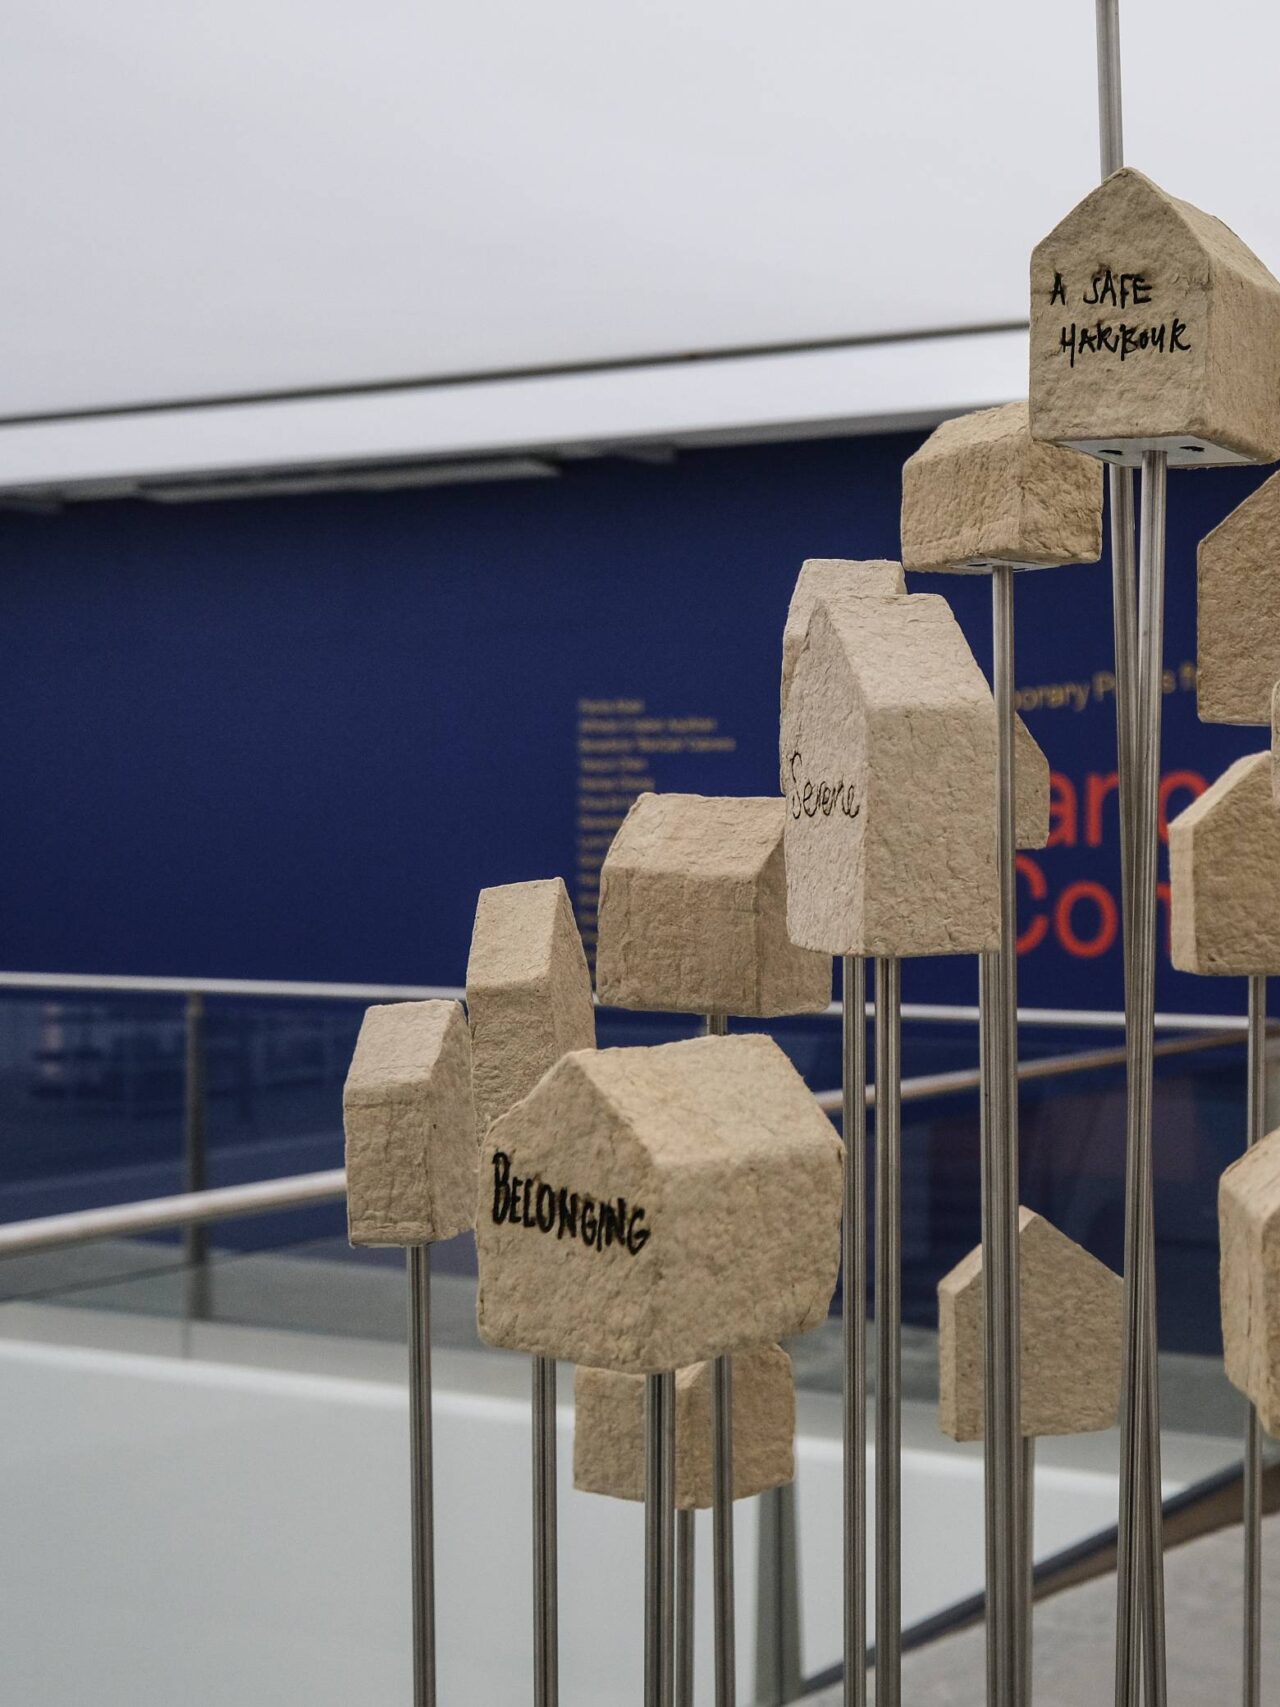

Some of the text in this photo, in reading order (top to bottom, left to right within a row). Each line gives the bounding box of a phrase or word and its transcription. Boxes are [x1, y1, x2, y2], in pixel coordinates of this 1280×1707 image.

[1050, 270, 1153, 309] A SAFE
[492, 1151, 651, 1256] BELONGING
